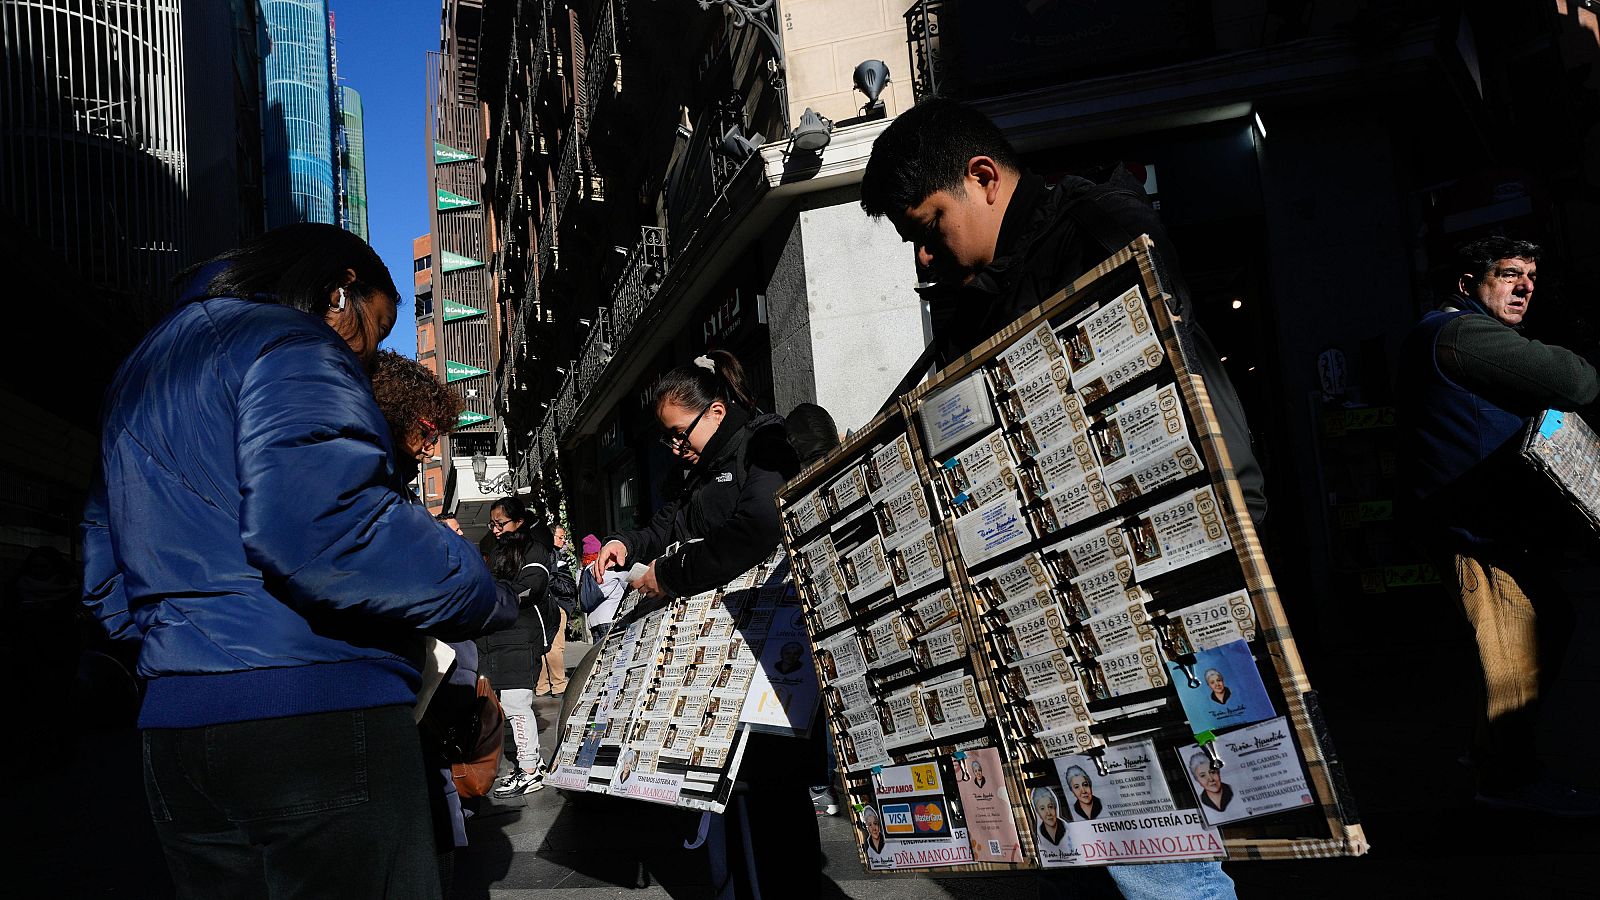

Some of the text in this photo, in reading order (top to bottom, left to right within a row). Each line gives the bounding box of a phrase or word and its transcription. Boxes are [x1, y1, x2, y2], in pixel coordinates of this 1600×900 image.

[1088, 304, 1123, 332] 28535
[1008, 338, 1039, 363] 83204
[1107, 357, 1145, 384] 28535
[1019, 372, 1050, 396] 36614
[1031, 405, 1062, 428] 53324
[1120, 402, 1157, 426] 86365
[964, 444, 991, 466] 97413
[1040, 445, 1073, 467] 68734
[1138, 458, 1176, 482] 86365
[890, 492, 912, 509] 50743
[1055, 483, 1087, 505] 12694
[1155, 502, 1195, 524] 96290
[904, 539, 926, 558] 28153
[1073, 537, 1106, 557] 14979
[1000, 566, 1028, 585] 66598
[1082, 571, 1115, 591] 23269
[1009, 599, 1037, 618] 19278
[1186, 606, 1228, 627] 63700
[1016, 618, 1045, 634] 16568
[1094, 614, 1128, 633] 31639
[1023, 661, 1053, 675] 21048
[1104, 654, 1139, 673] 39019
[1037, 695, 1067, 709] 72828
[1044, 734, 1074, 747] 20618
[889, 814, 907, 824] VISA
[1091, 819, 1138, 833] TENEMOS
[1139, 813, 1183, 829] LOTERÍA
[1082, 834, 1222, 859] DÑA.MANOLITA
